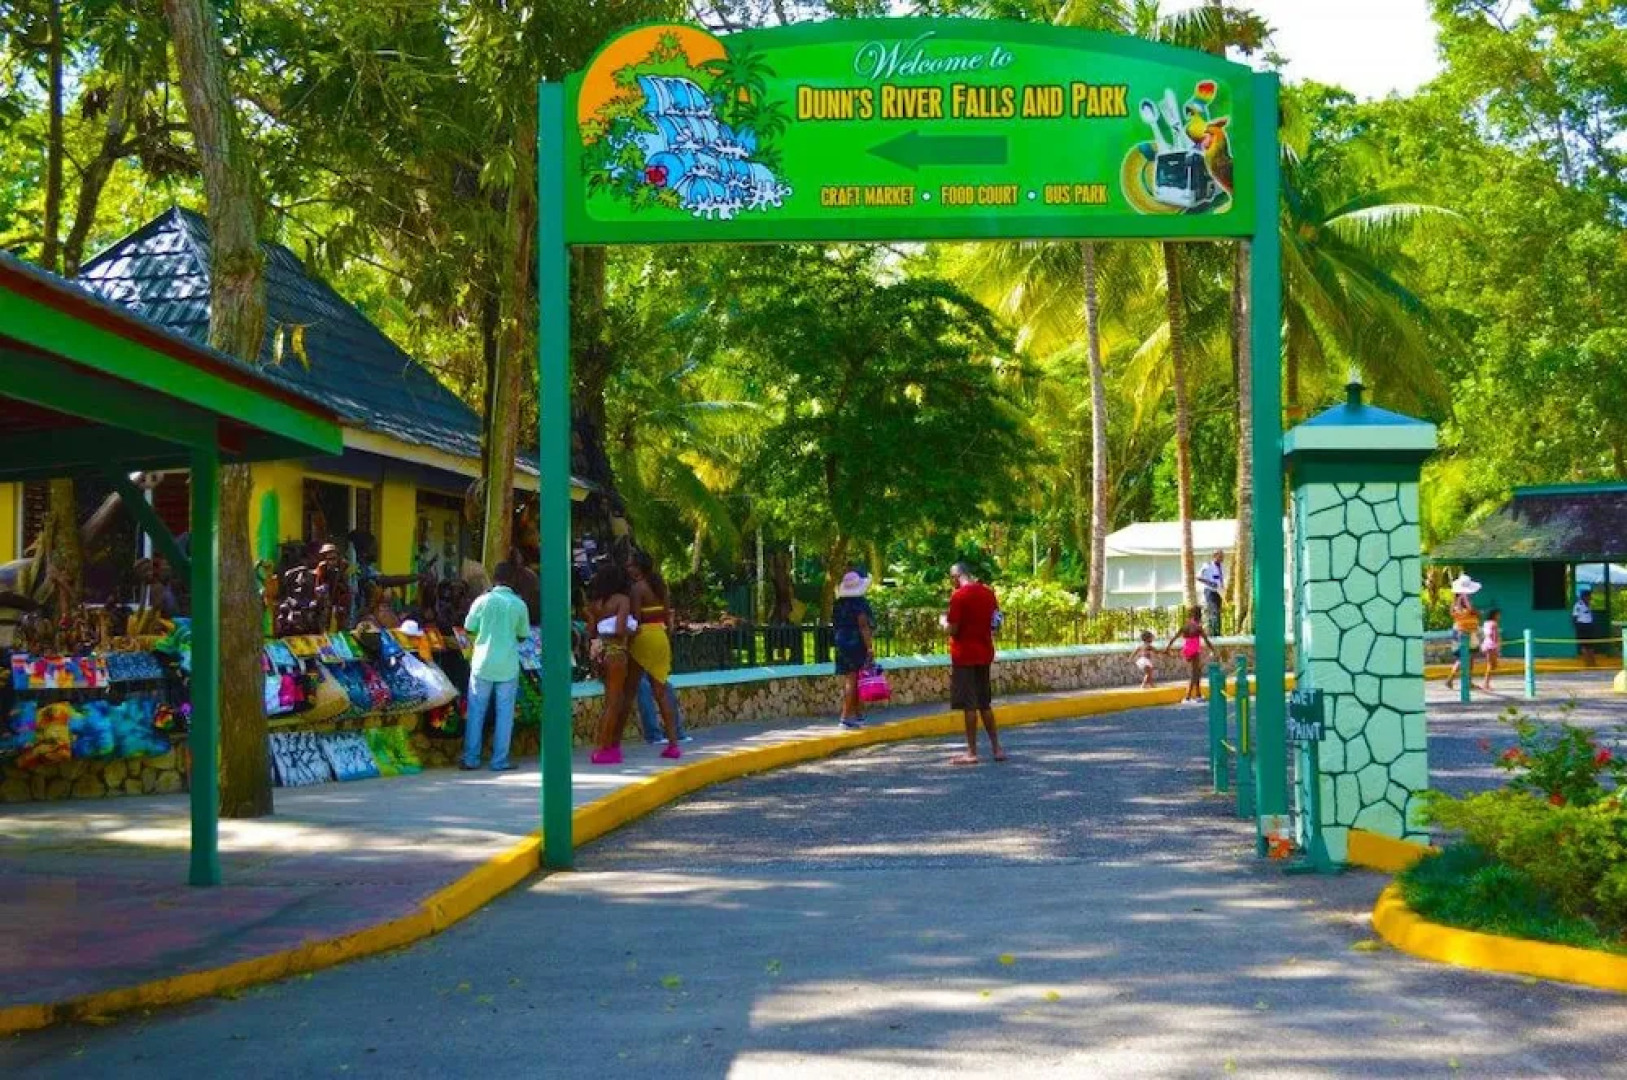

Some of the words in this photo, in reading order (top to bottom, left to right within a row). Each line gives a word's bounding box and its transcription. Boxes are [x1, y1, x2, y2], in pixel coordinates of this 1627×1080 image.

[854, 31, 982, 80] Welcome
[990, 46, 1013, 69] to
[797, 85, 873, 120] DUNN'S
[881, 84, 943, 119] RIVER
[952, 83, 1016, 119] FALLS
[1022, 85, 1064, 118] AND
[1071, 82, 1128, 118] PARK
[821, 186, 861, 206] CRAFT
[864, 186, 915, 206] MARKET
[941, 185, 975, 205] FOOD
[977, 185, 1019, 205] COURT
[1045, 184, 1070, 204] BUS
[1074, 184, 1108, 204] PARK
